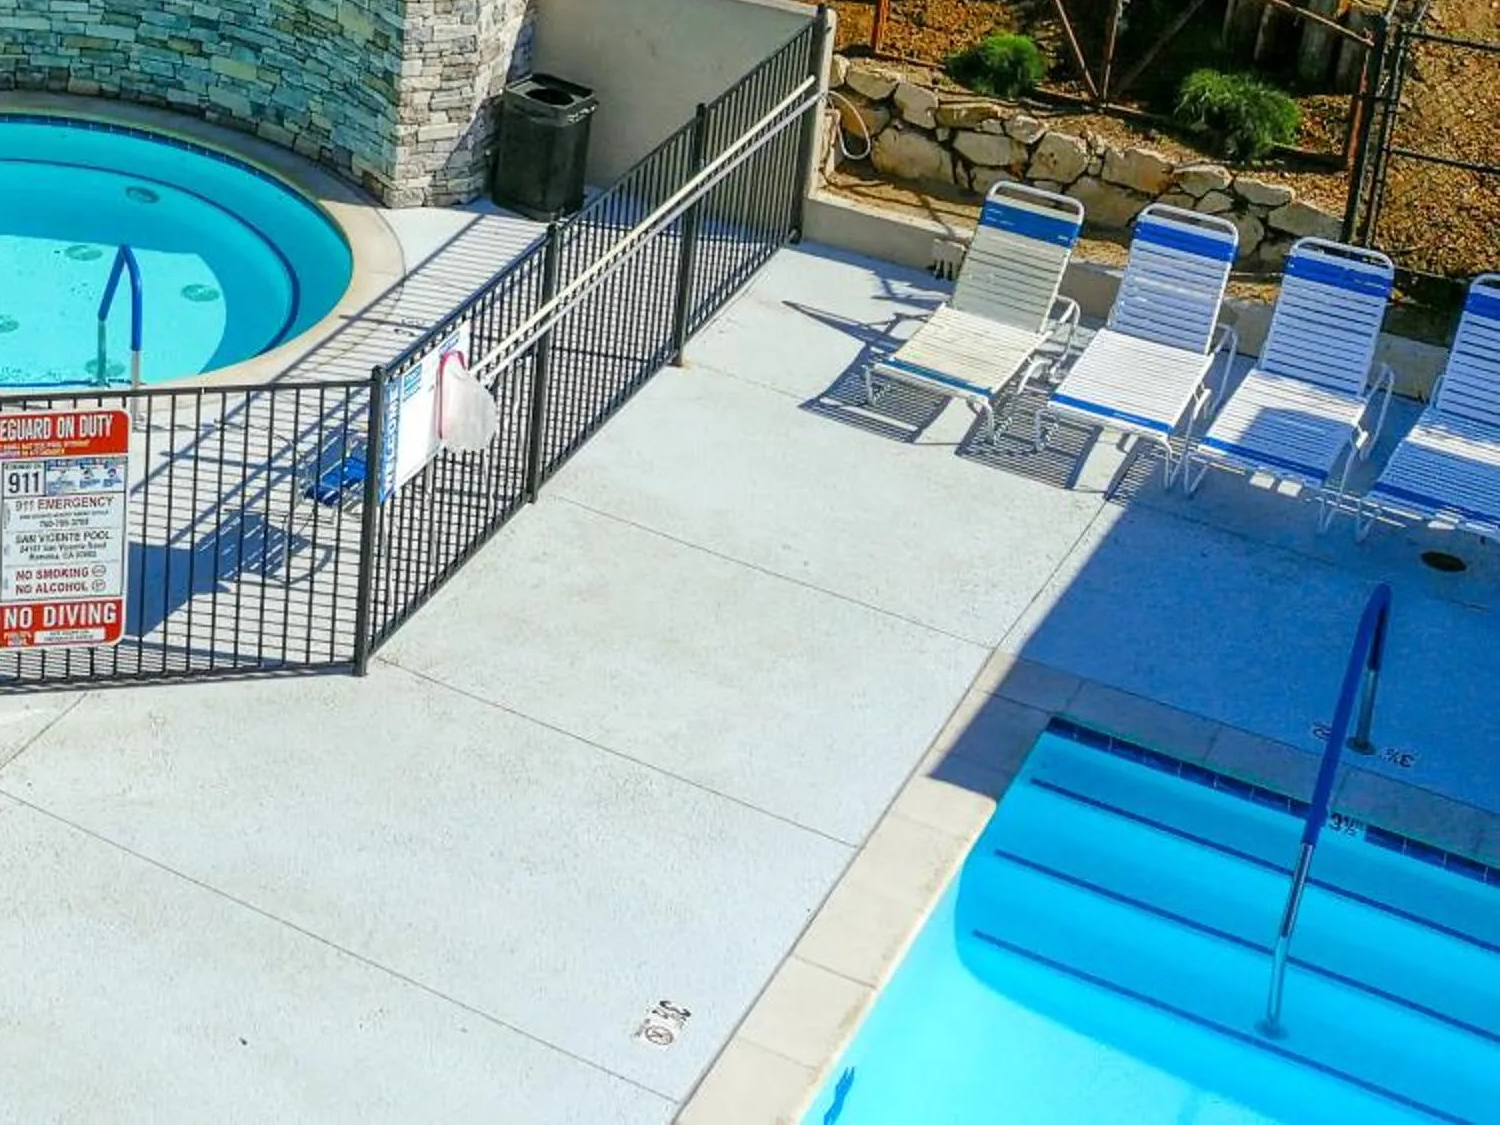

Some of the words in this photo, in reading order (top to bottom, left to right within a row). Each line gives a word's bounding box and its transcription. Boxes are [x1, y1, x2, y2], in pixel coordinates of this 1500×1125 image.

[57, 415, 75, 439] ON
[79, 413, 114, 438] DUTY
[8, 471, 40, 494] 911
[38, 496, 114, 510] EMERGENCY
[15, 570, 33, 582] NO
[35, 566, 89, 580] SMOKING
[15, 584, 32, 595] NO
[35, 582, 88, 594] ALCOHOL
[3, 606, 34, 630] NO
[43, 602, 117, 628] DIVING
